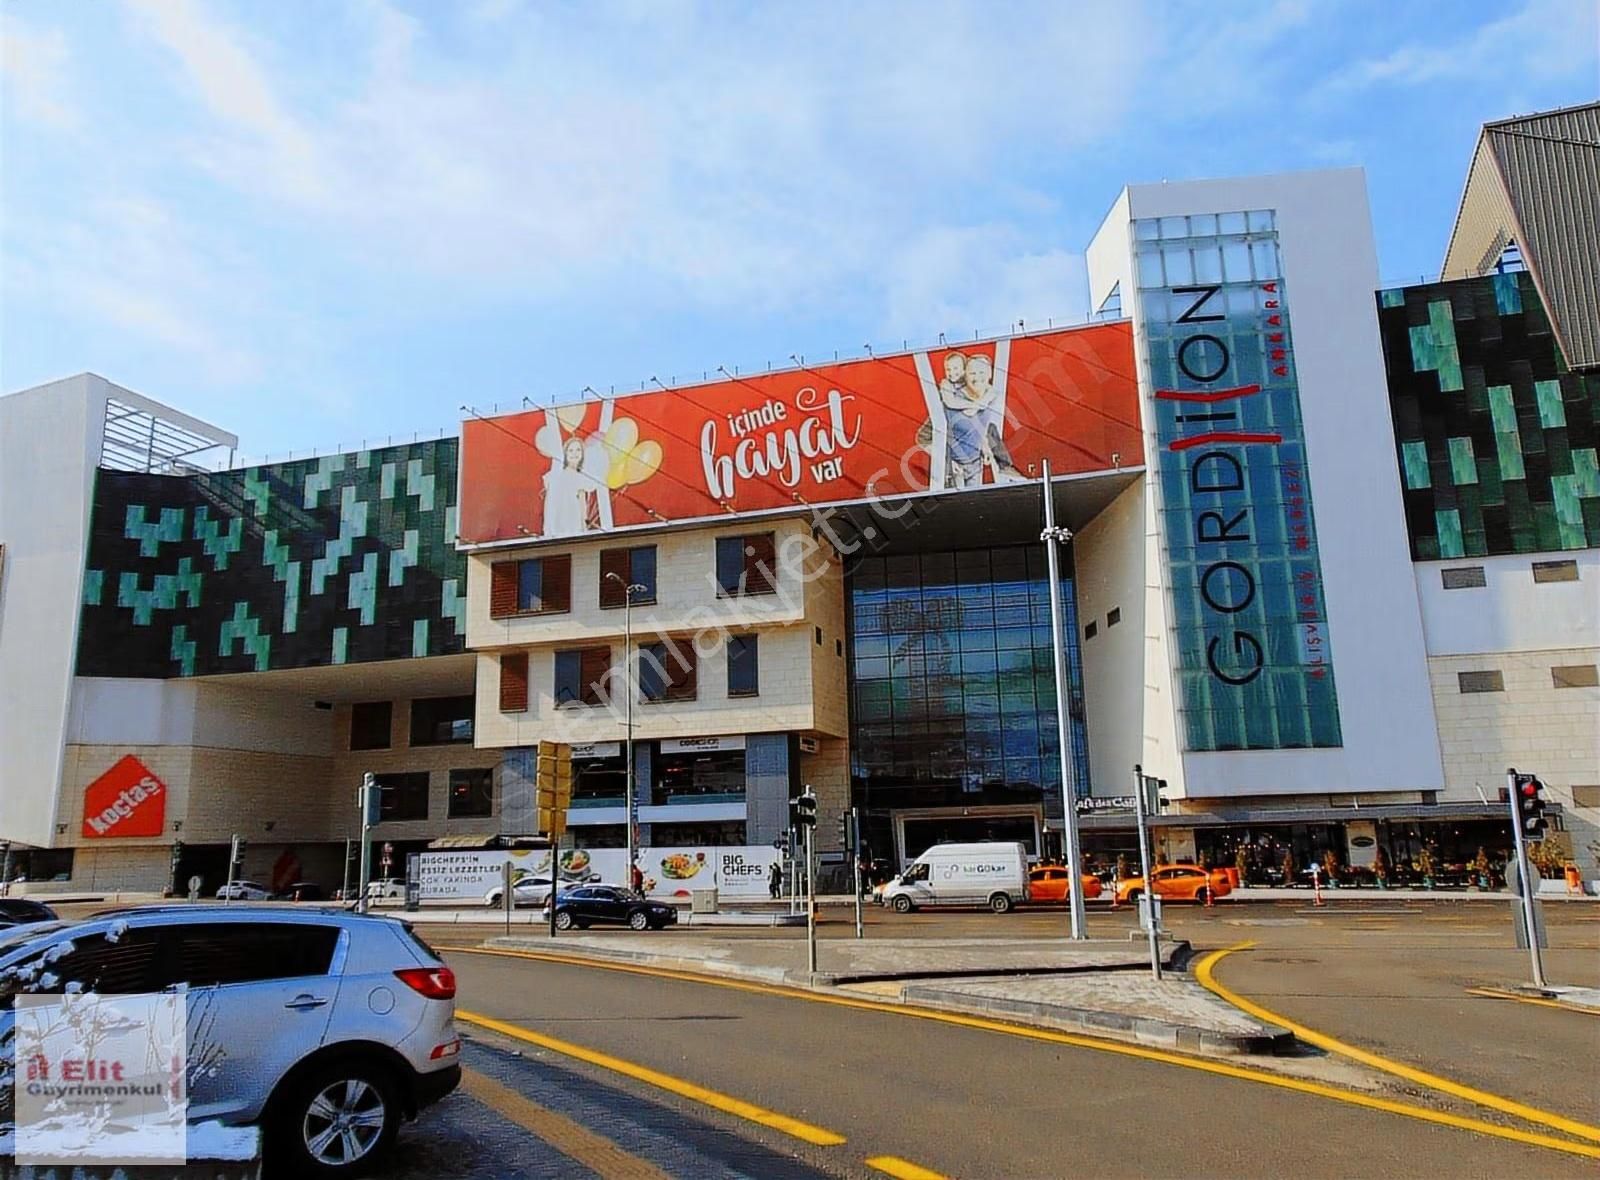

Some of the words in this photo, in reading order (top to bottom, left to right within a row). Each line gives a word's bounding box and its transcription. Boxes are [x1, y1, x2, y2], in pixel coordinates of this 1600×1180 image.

[1262, 282, 1289, 377] ANKARA
[727, 400, 787, 437] içinde
[701, 388, 863, 499] hayat
[810, 456, 843, 484] var
[1172, 285, 1264, 686] GORDION
[722, 854, 744, 865] BIG
[722, 865, 762, 875] CHEFS
